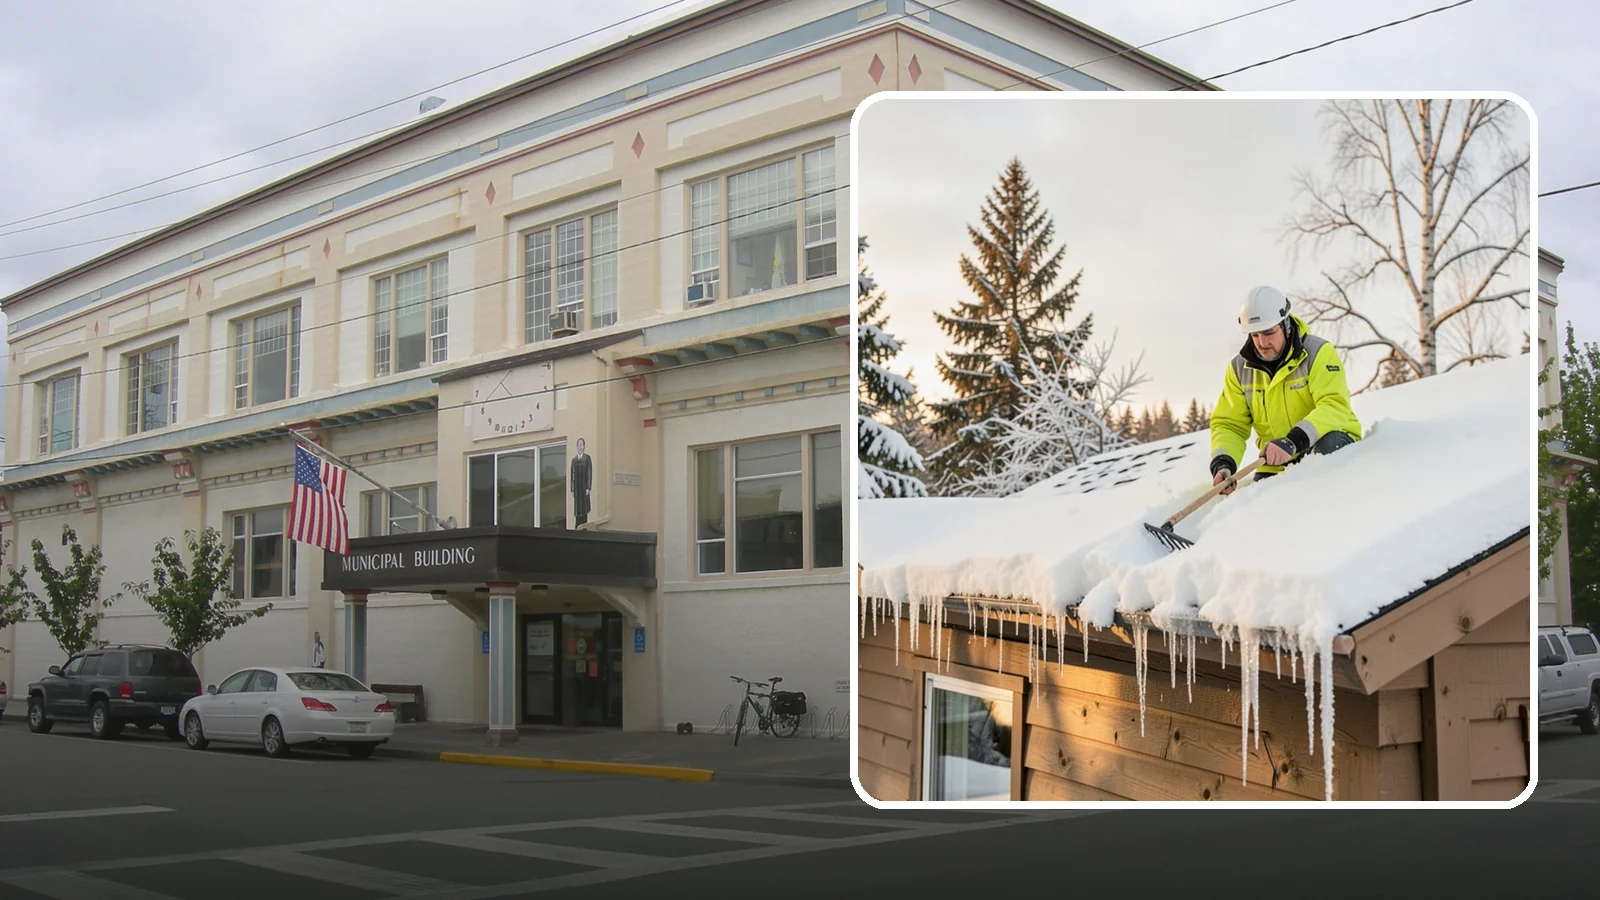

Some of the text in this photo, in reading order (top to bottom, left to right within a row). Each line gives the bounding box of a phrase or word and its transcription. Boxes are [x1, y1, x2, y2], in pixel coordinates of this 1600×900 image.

[480, 407, 485, 415] 8
[488, 418, 492, 426] 9
[494, 424, 500, 432] 10
[501, 425, 506, 433] 11
[507, 425, 513, 433] 12
[521, 420, 525, 428] 2
[529, 414, 533, 422] 3
[342, 546, 475, 572] MUNICIPAL BUILDING
